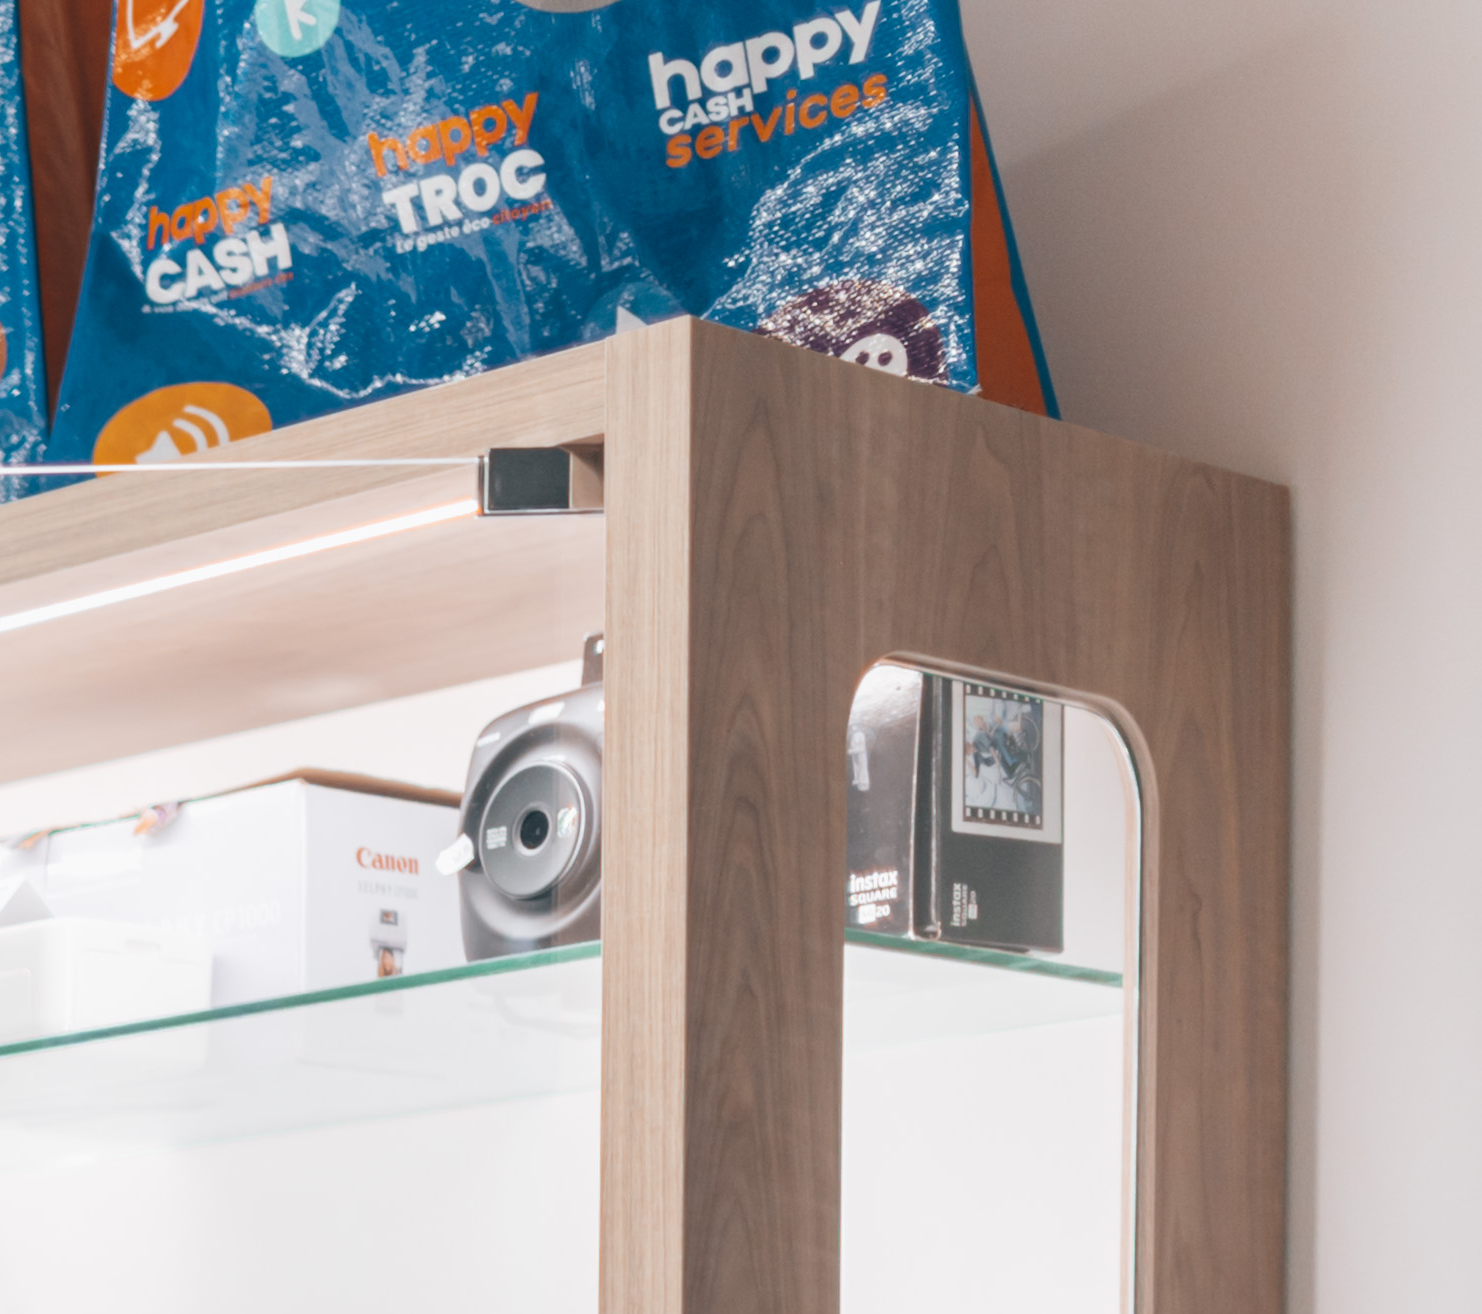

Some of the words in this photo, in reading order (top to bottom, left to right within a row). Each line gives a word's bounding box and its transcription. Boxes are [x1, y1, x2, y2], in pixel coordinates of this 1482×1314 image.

[648, 0, 881, 110] happy
[368, 92, 538, 177] happy
[659, 88, 753, 135] CASH
[667, 74, 887, 168] services
[148, 176, 273, 251] happy
[383, 149, 547, 235] TROC
[146, 223, 293, 304] CASH
[356, 847, 419, 875] Canon
[849, 887, 897, 906] SQUARE
[850, 870, 898, 893] instax
[950, 883, 961, 927] instax
